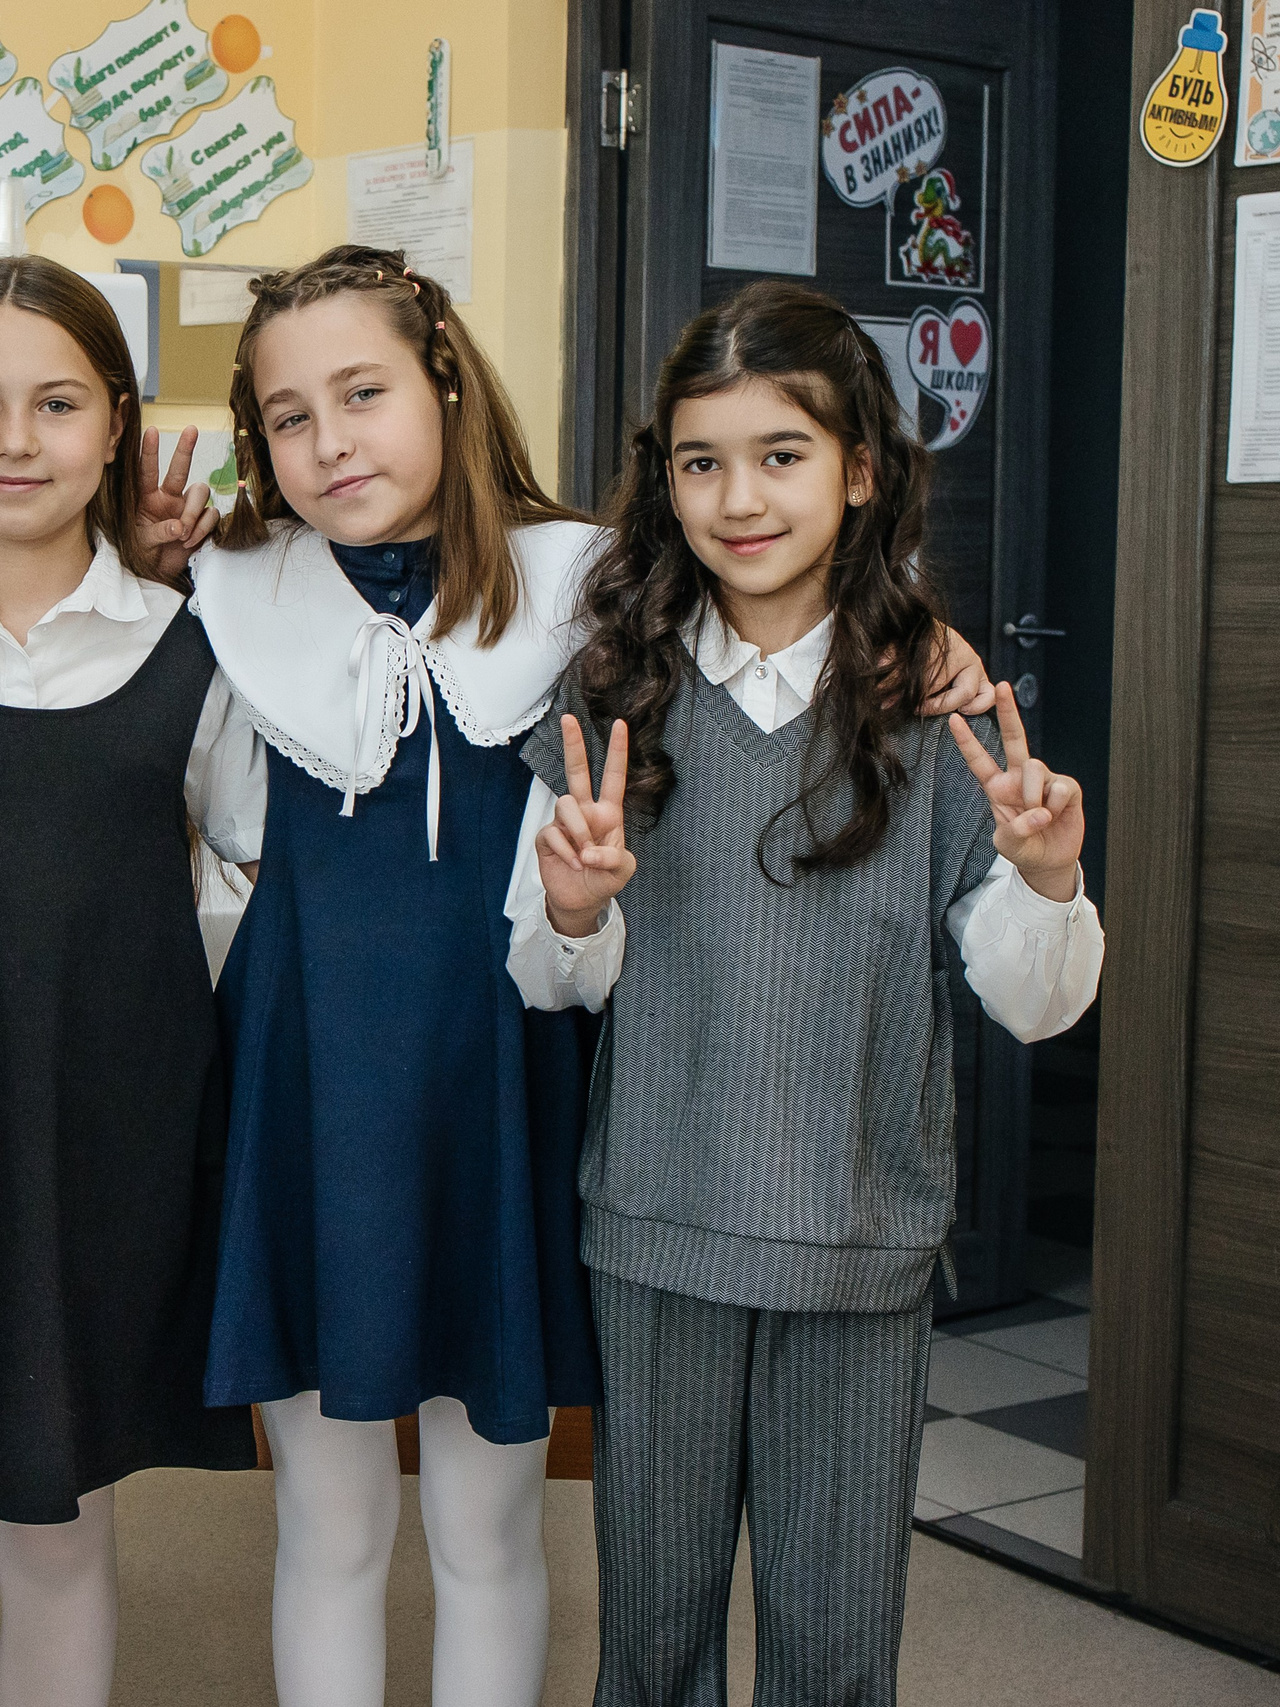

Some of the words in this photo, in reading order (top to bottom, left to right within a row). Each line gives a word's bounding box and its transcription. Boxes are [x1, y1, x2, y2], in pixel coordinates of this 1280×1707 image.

[74, 63, 116, 95] Книга
[1169, 74, 1215, 107] БУДЬ
[139, 96, 172, 123] беде
[1148, 104, 1219, 133] АКТИВНЫМ!
[191, 149, 204, 165] С
[204, 123, 247, 158] книгой
[261, 131, 286, 157] ума
[844, 164, 858, 195] В
[860, 106, 941, 184] ЗНАНИЯХ!
[919, 319, 939, 366] Я
[931, 369, 985, 391] ШКОЛУ
